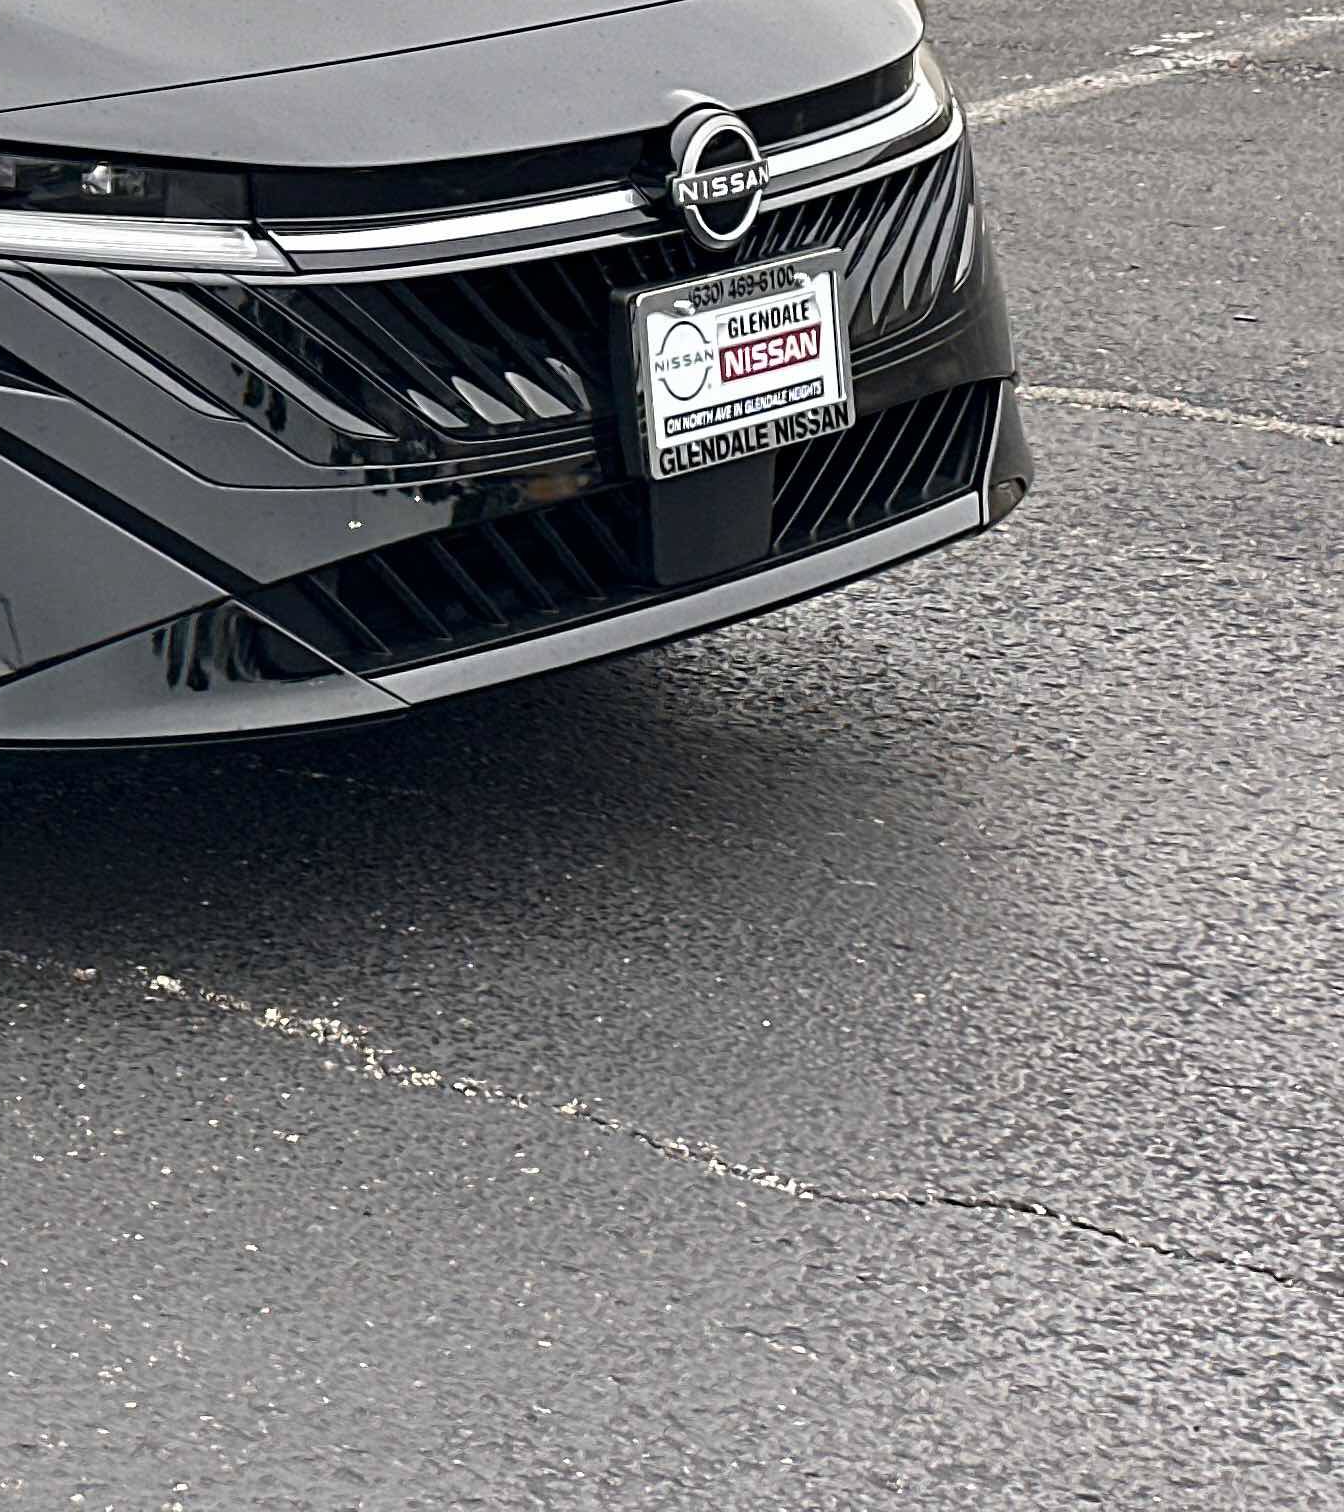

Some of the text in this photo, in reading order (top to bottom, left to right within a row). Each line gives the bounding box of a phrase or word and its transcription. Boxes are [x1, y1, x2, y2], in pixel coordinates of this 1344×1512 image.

[678, 165, 769, 203] NISSAN
[728, 265, 795, 299] 469-6100
[727, 298, 810, 339] GLENDALE
[654, 348, 714, 375] NISSAN
[724, 328, 818, 378] NISSAN
[667, 418, 682, 434] ON
[682, 408, 714, 429] NORTH
[715, 404, 732, 422] AVE
[733, 401, 744, 417] IN
[745, 389, 787, 414] GLENDALE
[659, 402, 849, 475] GLENDALE NISSAN
